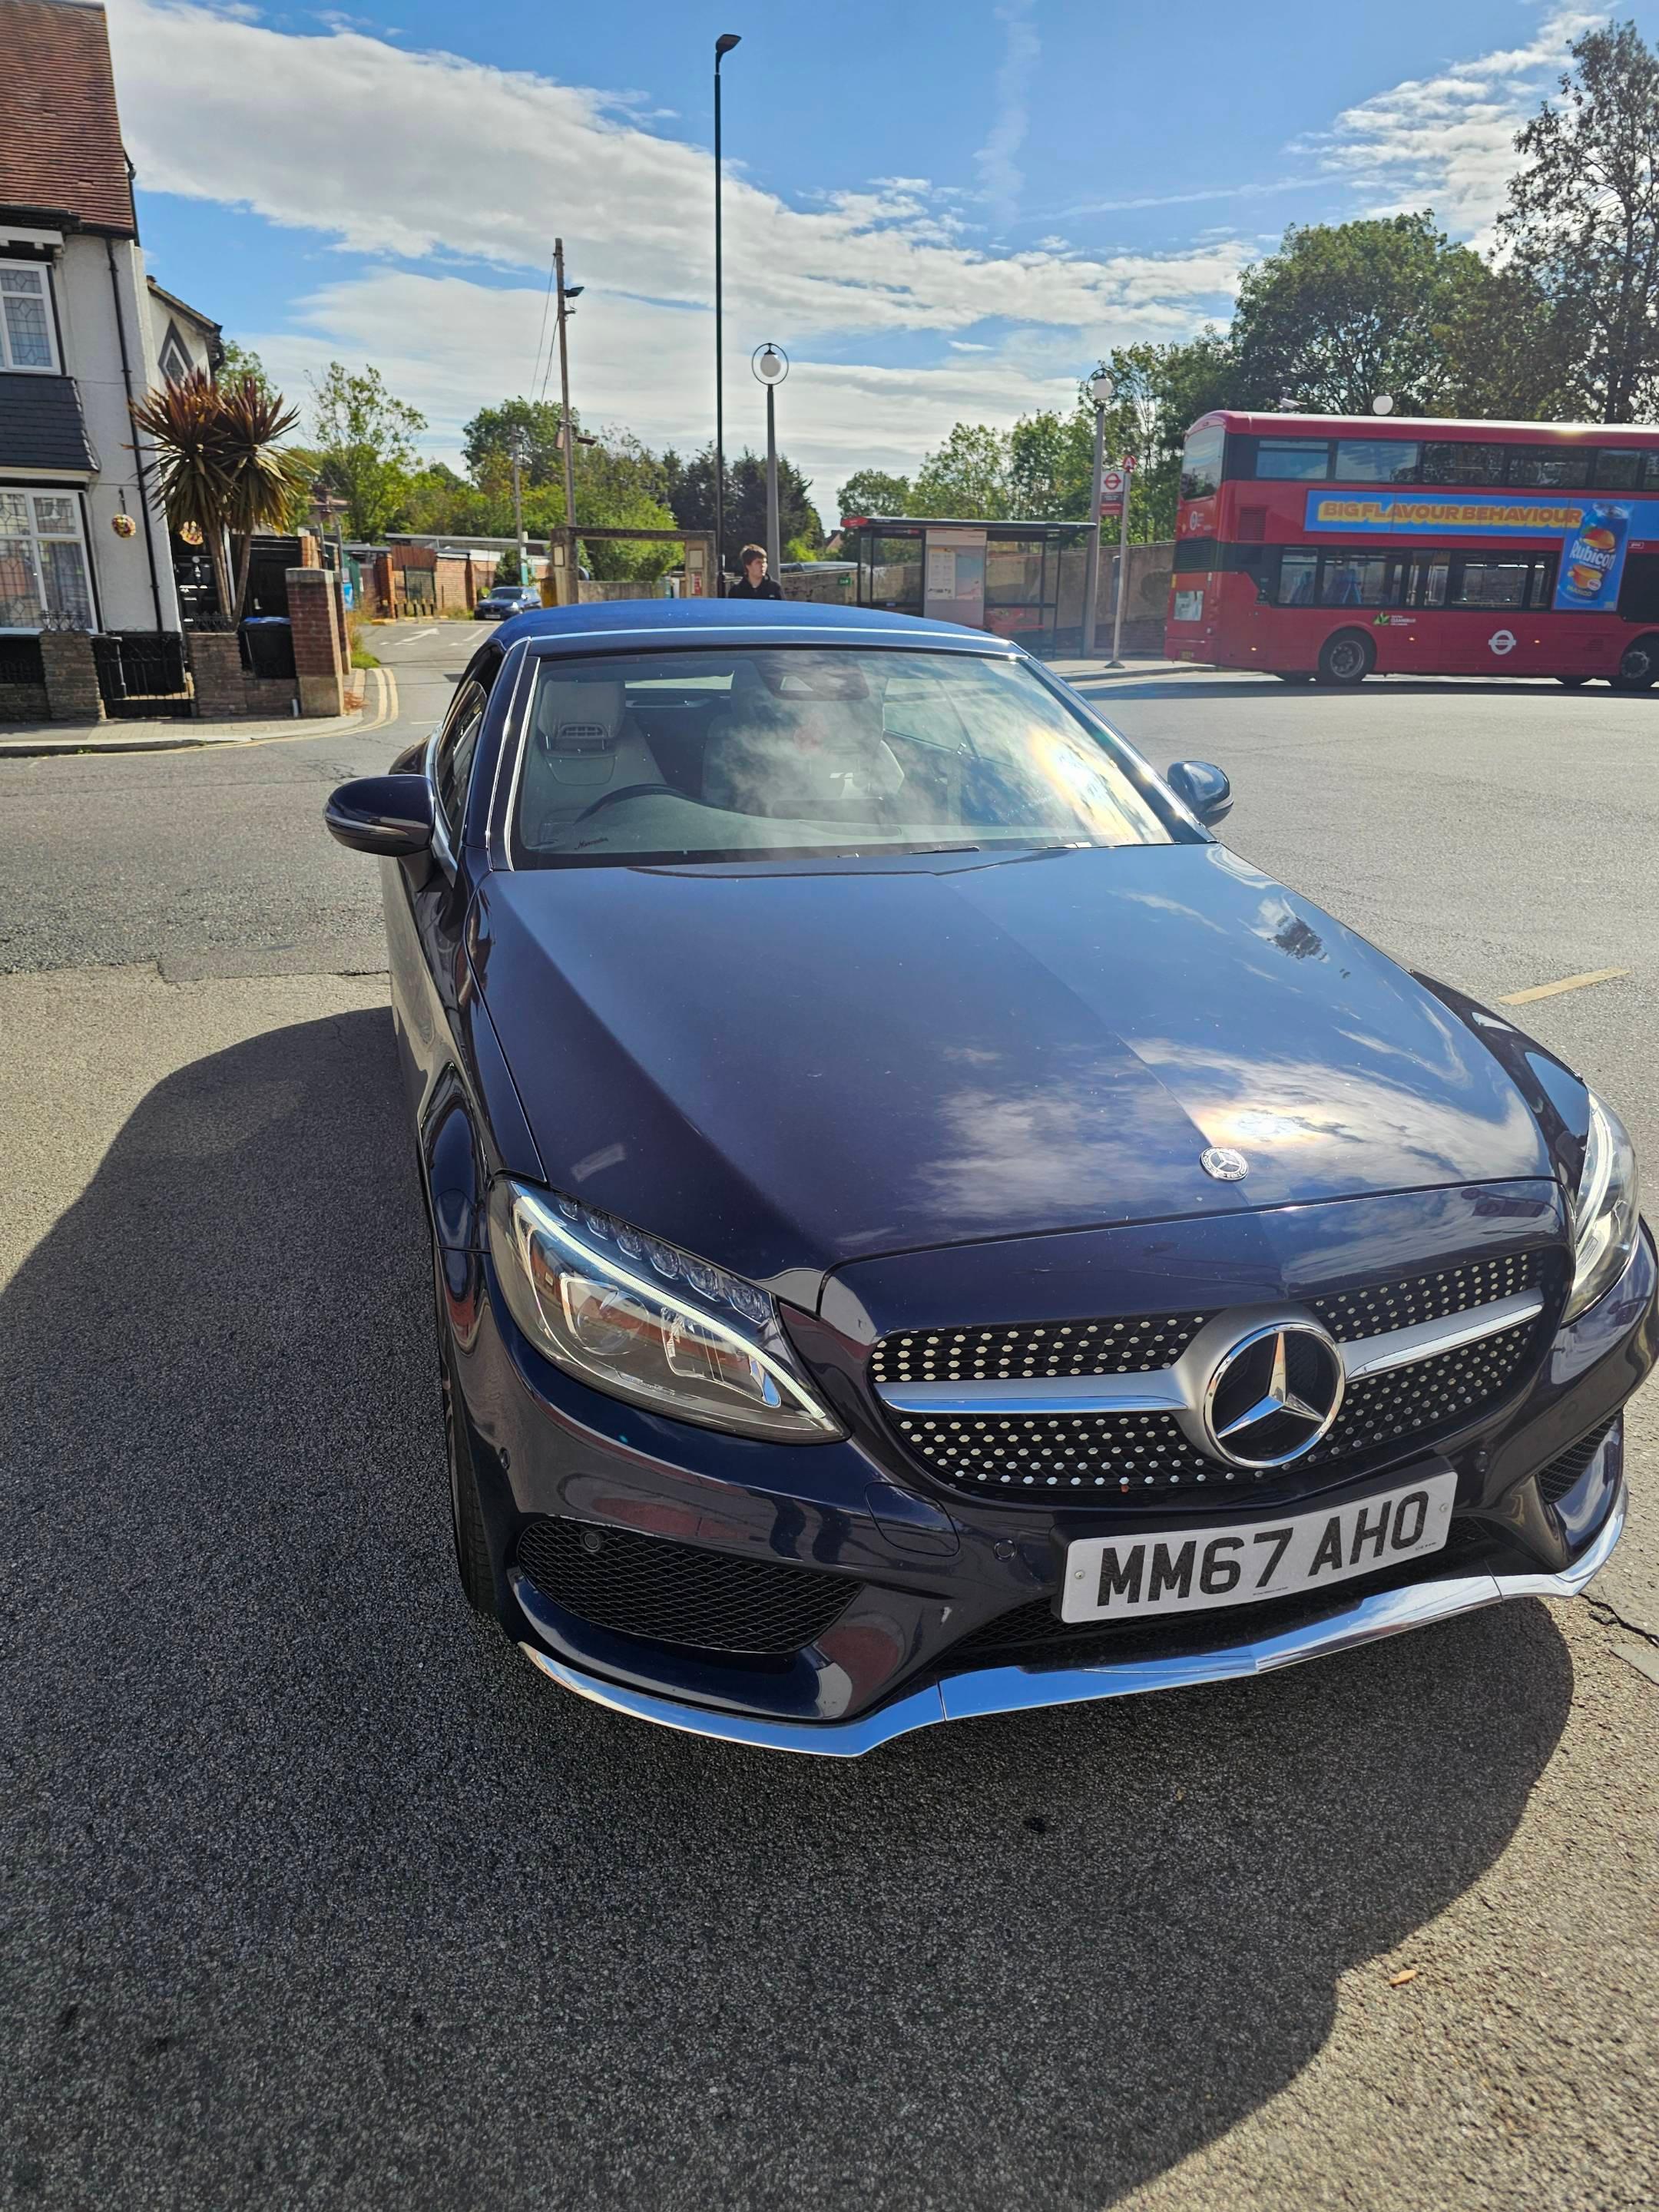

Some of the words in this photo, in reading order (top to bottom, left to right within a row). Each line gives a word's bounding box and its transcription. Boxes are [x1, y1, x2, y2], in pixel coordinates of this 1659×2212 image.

[1124, 457, 1134, 468] A
[1321, 502, 1361, 520] BIG
[1362, 502, 1460, 524] FLAVOUR
[1461, 505, 1581, 526] BEHAVIOUR
[1569, 540, 1616, 571] Rubicon
[1097, 1527, 1293, 1607] MM67
[1308, 1491, 1429, 1578] AHO
